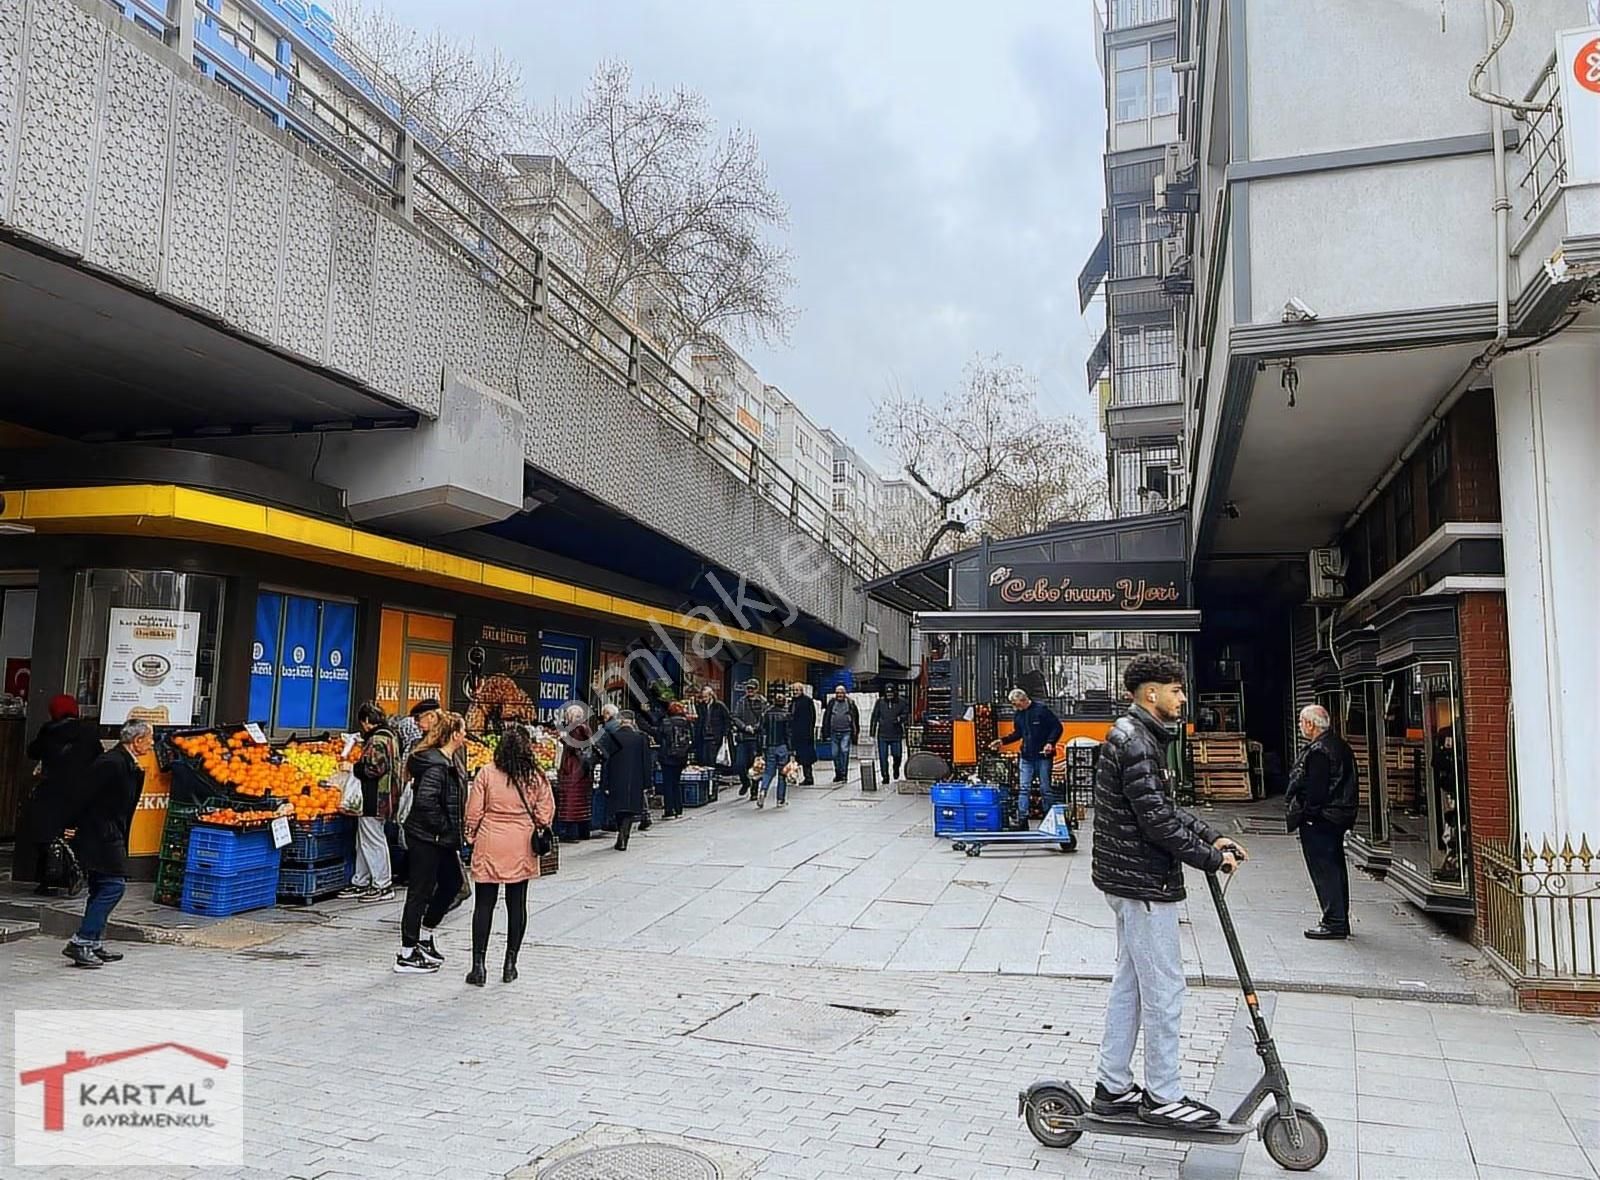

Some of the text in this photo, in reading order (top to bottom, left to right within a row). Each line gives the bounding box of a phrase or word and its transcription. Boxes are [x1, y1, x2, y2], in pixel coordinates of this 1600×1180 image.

[1000, 577, 1180, 611] Cebo'nun Yeri
[539, 682, 570, 700] KENTE
